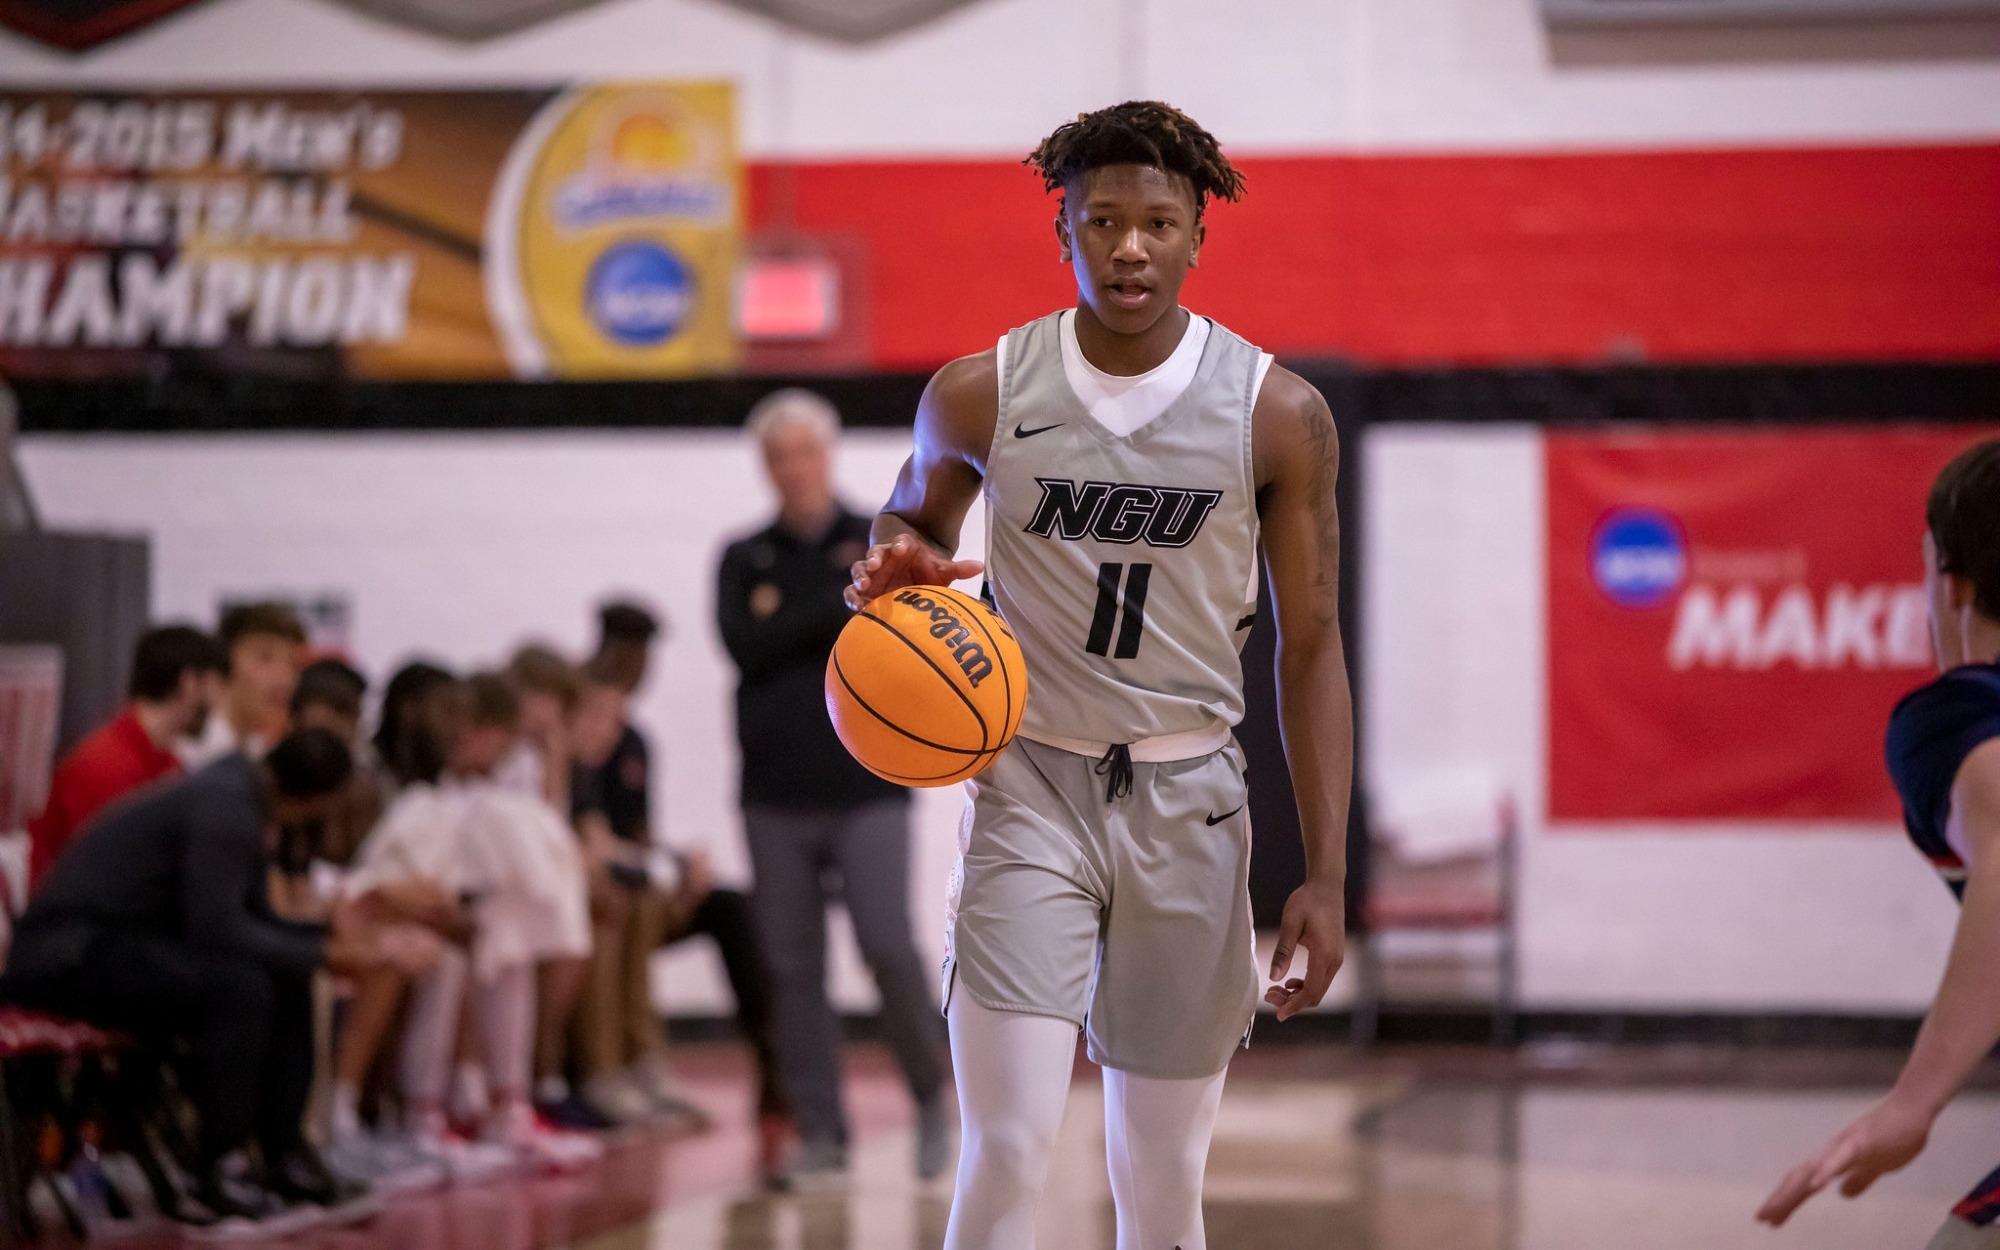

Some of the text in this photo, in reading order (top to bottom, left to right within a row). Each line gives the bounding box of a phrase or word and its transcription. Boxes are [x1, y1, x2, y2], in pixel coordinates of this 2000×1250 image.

[1022, 477, 1224, 548] NGU
[893, 591, 993, 689] Wilson
[1086, 562, 1152, 659] 11
